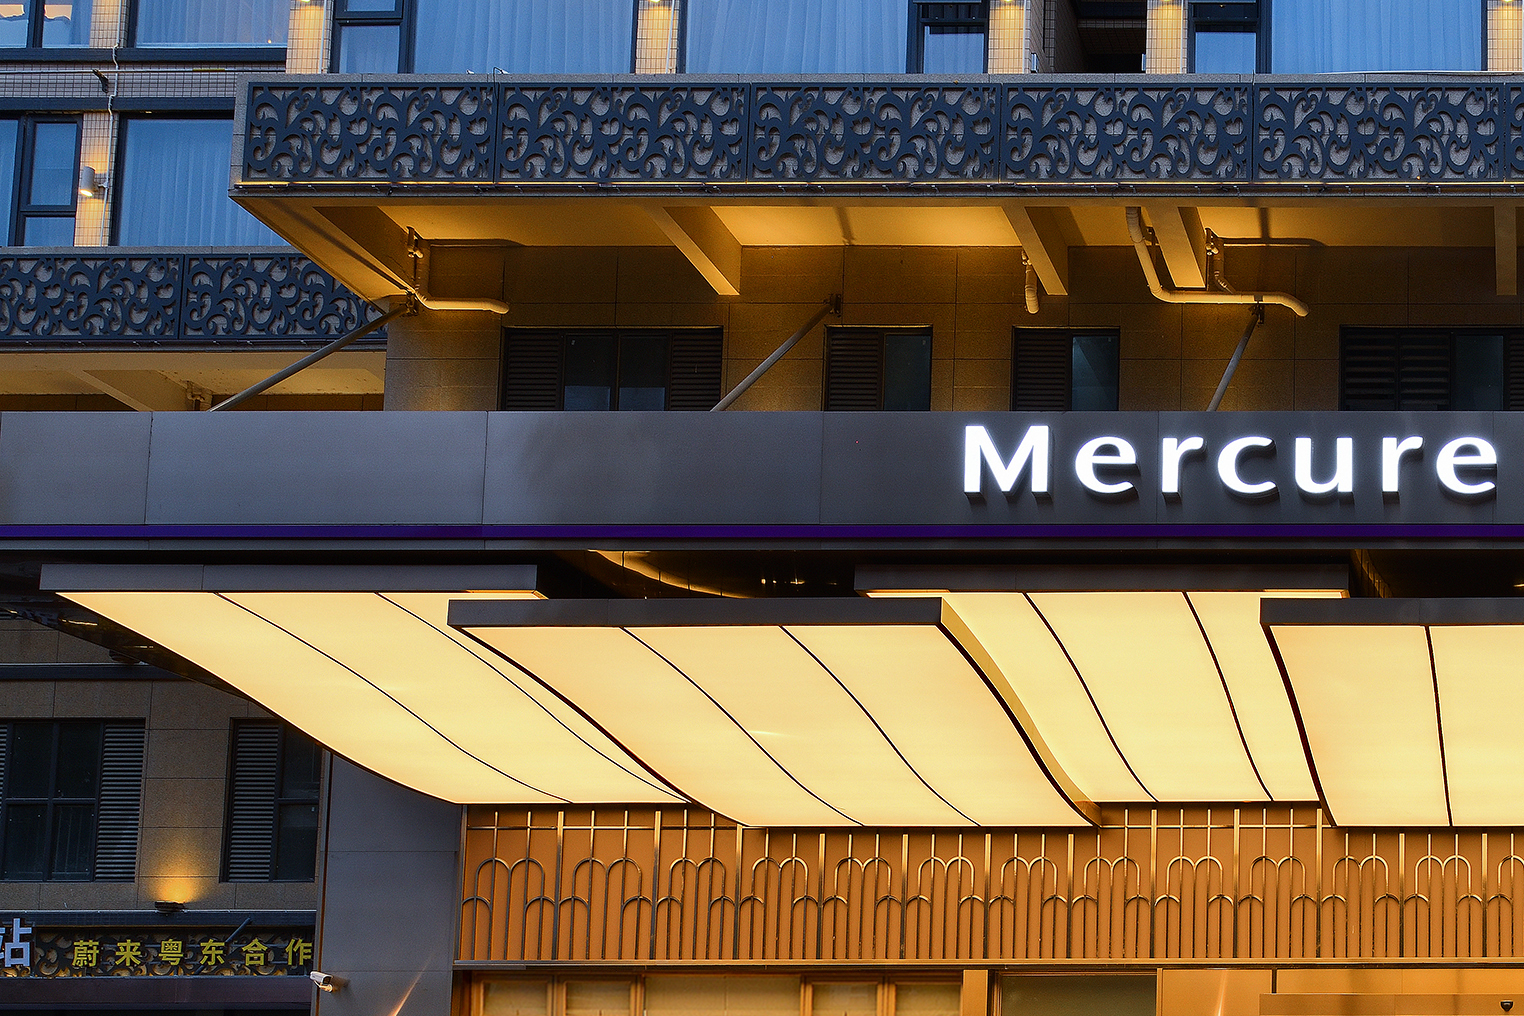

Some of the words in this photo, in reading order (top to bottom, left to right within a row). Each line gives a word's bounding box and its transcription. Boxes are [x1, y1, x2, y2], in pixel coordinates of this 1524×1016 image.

[964, 425, 1498, 494] Mercure
[72, 938, 313, 967] 蔚来粤东合作
